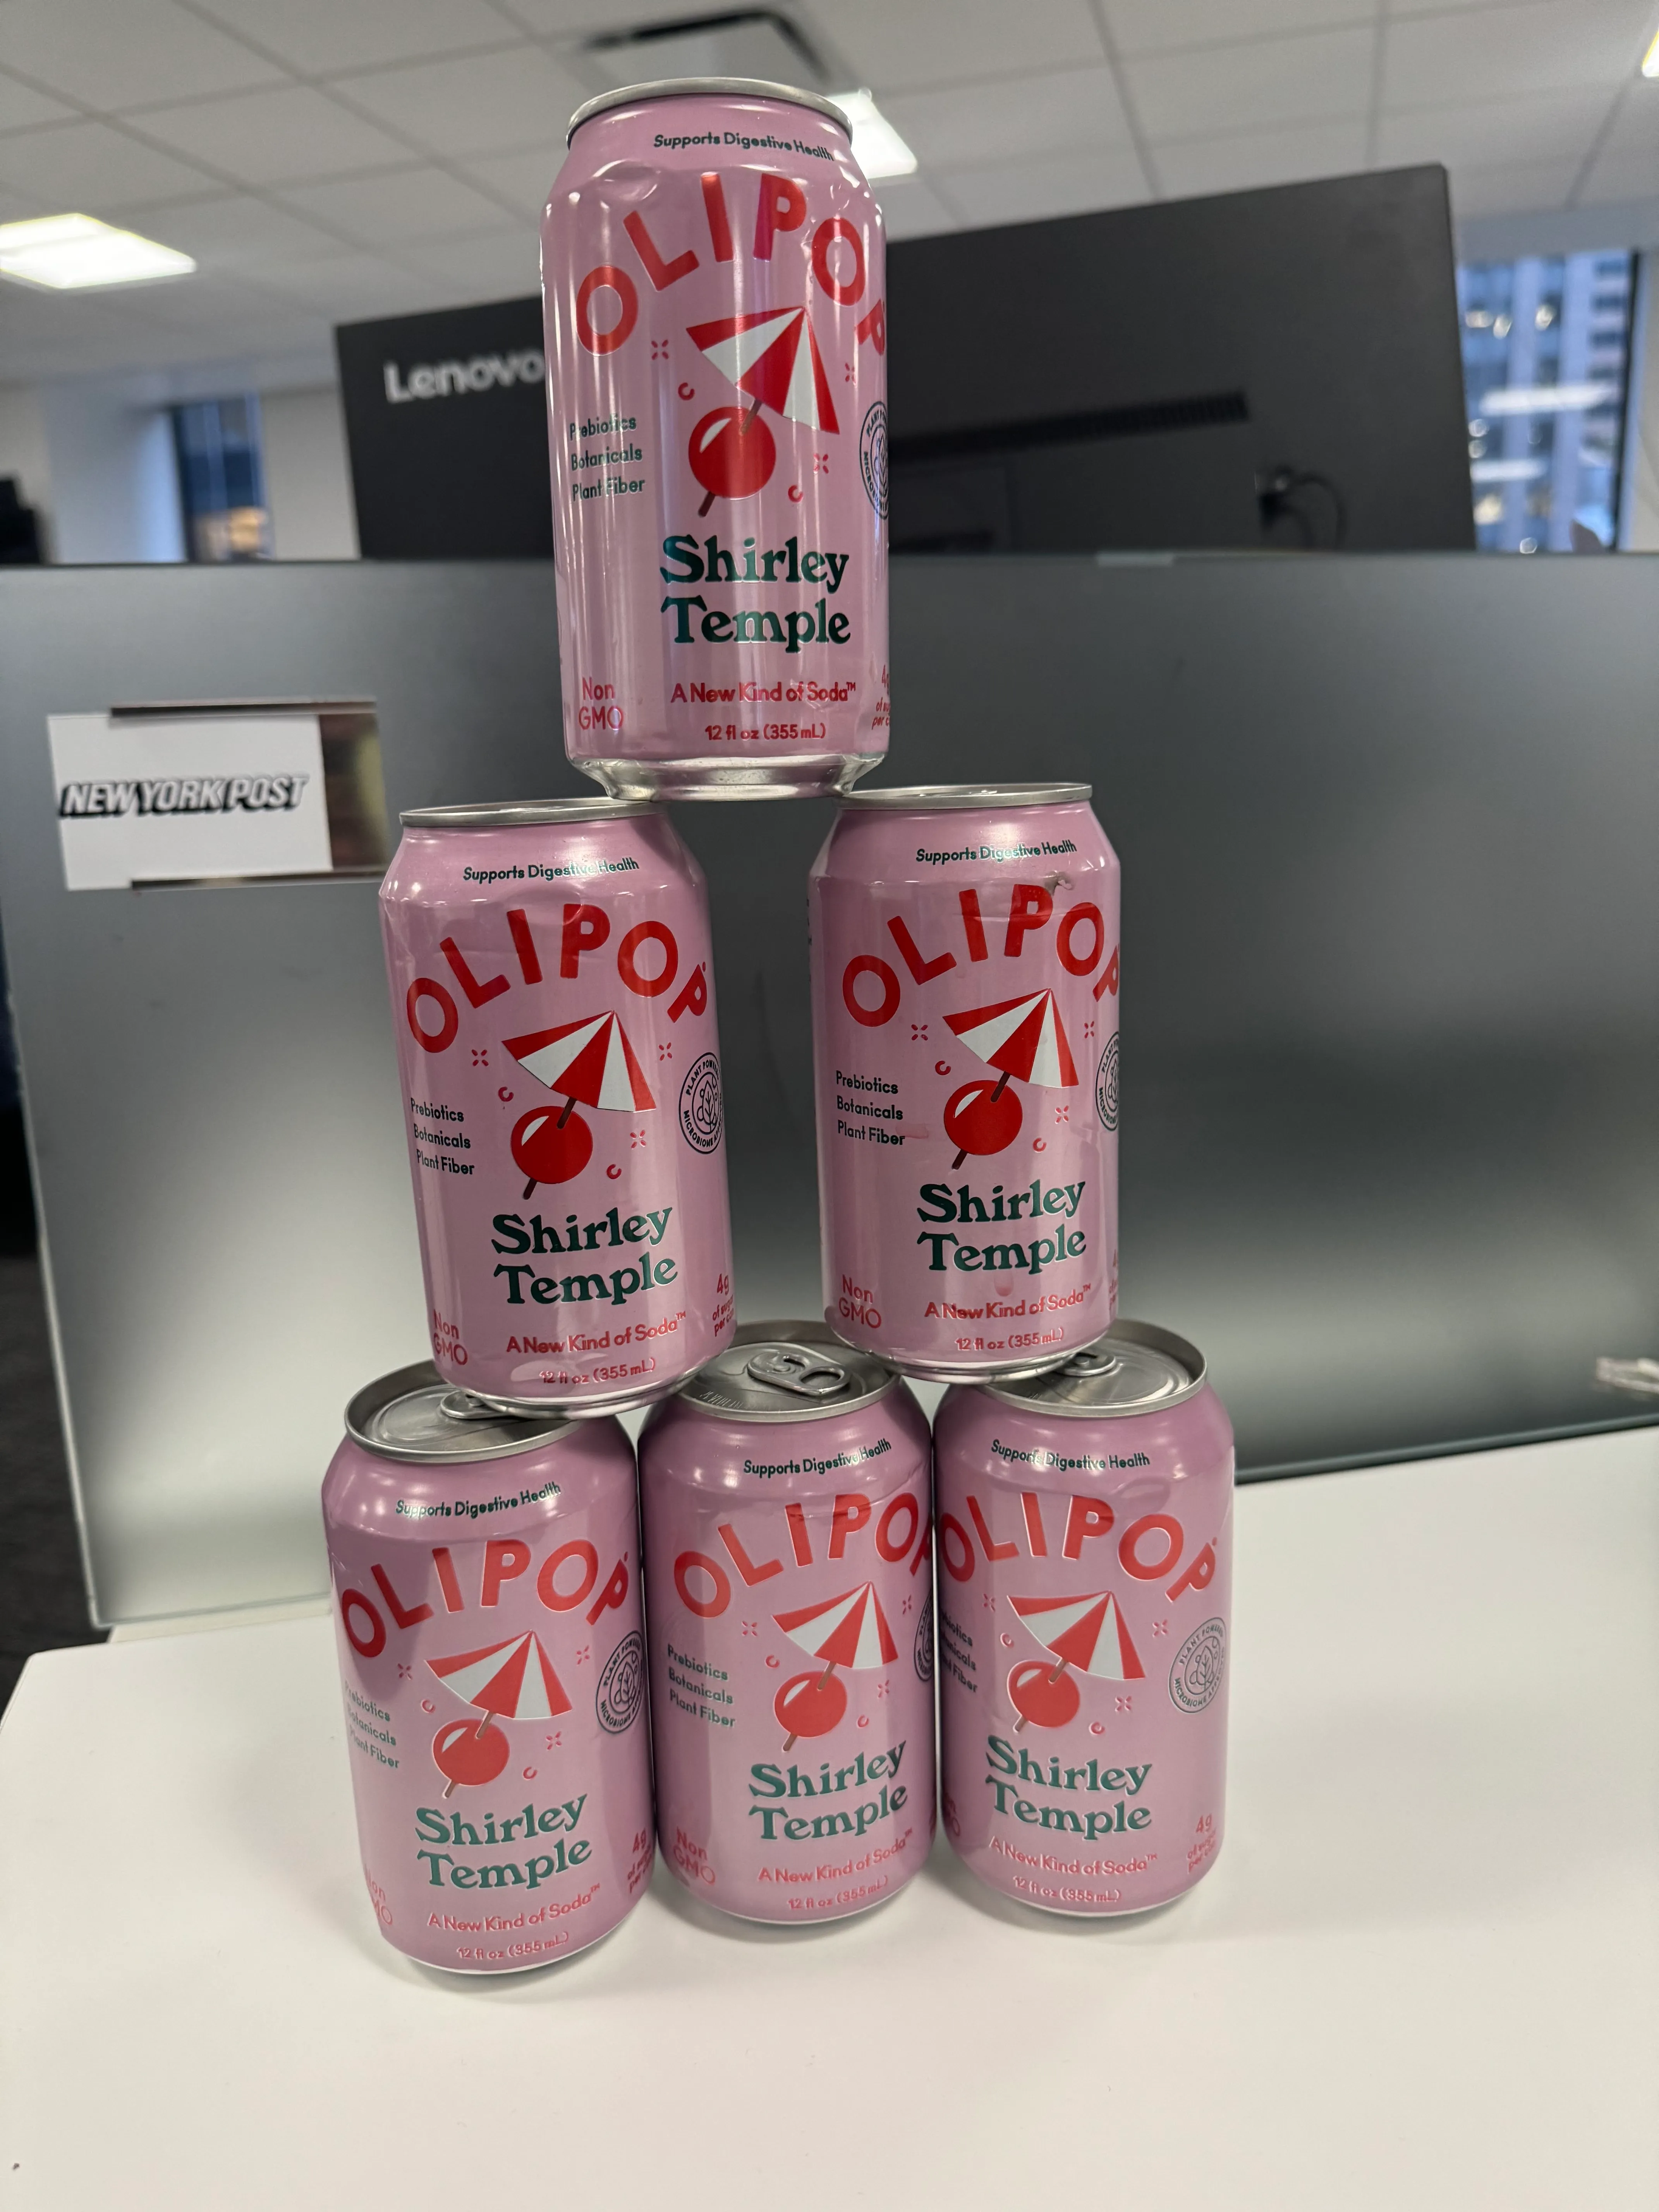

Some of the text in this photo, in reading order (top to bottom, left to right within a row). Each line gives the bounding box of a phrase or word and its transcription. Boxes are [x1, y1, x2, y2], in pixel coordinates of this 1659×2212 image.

[654, 132, 834, 160] Supports Digestive Health
[576, 173, 885, 356] OLIPOP
[384, 349, 545, 404] Lenovo
[570, 412, 636, 441] Prebiotics
[572, 443, 642, 471] Botanicals
[573, 477, 644, 502] Plant Fiber
[660, 534, 849, 594] Shirley
[661, 595, 851, 653] Temple
[582, 677, 614, 701] Non
[671, 684, 687, 703] A
[690, 683, 735, 703] New
[739, 681, 782, 703] Kind
[786, 682, 805, 701] of
[579, 706, 624, 730] GMO
[705, 723, 826, 740] 12 fl oz (355 mL)
[60, 776, 309, 819] NEW YORK POST
[916, 840, 1077, 865] Supports Digestive Health
[464, 858, 639, 884] Supports Digestive Health
[842, 884, 1119, 1028] OLIPOP
[407, 903, 708, 1053] OLIPOP
[686, 1065, 701, 1096] PLANT
[836, 1070, 898, 1094] Prebiotics
[411, 1097, 464, 1122] Prebiotics
[837, 1095, 903, 1120] Botanicals
[414, 1123, 471, 1149] Botanicals
[838, 1120, 905, 1146] Plant Fiber
[417, 1149, 474, 1175] Plant Fiber
[917, 1179, 1085, 1223] Shirley
[491, 1207, 672, 1254] Shirley
[917, 1224, 1087, 1275] Temple
[493, 1252, 678, 1305] Temple
[717, 1273, 729, 1295] 4g
[842, 1274, 873, 1304] Non
[712, 1304, 720, 1321] of
[839, 1296, 882, 1329] GMO
[924, 1302, 940, 1318] A
[942, 1302, 984, 1319] New
[986, 1300, 1026, 1319] Kind
[1029, 1296, 1045, 1314] of
[433, 1309, 459, 1339] Non
[714, 1317, 725, 1337] per
[955, 1327, 1064, 1351] 12 fl oz (355 mL)
[433, 1333, 468, 1366] GMO
[507, 1336, 522, 1353] A
[523, 1336, 564, 1353] New
[568, 1331, 611, 1352] Kind
[614, 1327, 632, 1346] of
[539, 1370, 556, 1384] 12
[572, 1373, 591, 1384] oz
[593, 1366, 628, 1383] (355
[630, 1357, 656, 1376] mL)
[744, 1438, 892, 1479] Supports Digestive Health
[991, 1439, 1150, 1472] Supports Digestive Health
[396, 1481, 561, 1519] Supports Digestive Health
[940, 1492, 1216, 1602] OLIPOP
[342, 1539, 629, 1658] OLIPOP
[667, 1644, 728, 1681] Prebiotics
[1178, 1634, 1200, 1665] PLANT
[668, 1667, 734, 1705] Botanicals
[953, 1662, 978, 1693] Fiber
[345, 1680, 390, 1722] Prebiotics
[670, 1688, 736, 1728] Plant Fiber
[370, 1743, 400, 1769] Fiber
[749, 1740, 907, 1798] Shirley
[986, 1734, 1152, 1795] Shirley
[415, 1793, 587, 1844] Shirley
[749, 1785, 908, 1841] Temple
[985, 1774, 1152, 1840] Temple
[1195, 1813, 1212, 1833] 4g
[676, 1825, 708, 1860] Non
[989, 1835, 1003, 1855] A
[1003, 1846, 1038, 1868] New
[1041, 1854, 1080, 1874] Kind
[1083, 1858, 1100, 1875] of
[417, 1839, 592, 1889] Temple
[673, 1844, 716, 1886] GMO
[758, 1867, 772, 1882] A
[774, 1866, 813, 1882] New
[816, 1861, 853, 1881] Kind
[855, 1854, 872, 1872] of
[788, 1874, 889, 1910] 12 fl oz (355 mL)
[1013, 1876, 1027, 1890] 12
[1041, 1886, 1056, 1897] oz
[1060, 1887, 1094, 1902] (355
[1096, 1888, 1121, 1903] mL)
[428, 1913, 442, 1927] A
[443, 1914, 482, 1932] New
[485, 1910, 525, 1931] Kind
[528, 1907, 546, 1925] of
[457, 1931, 570, 1960] 12 fl oz (355 mL)
